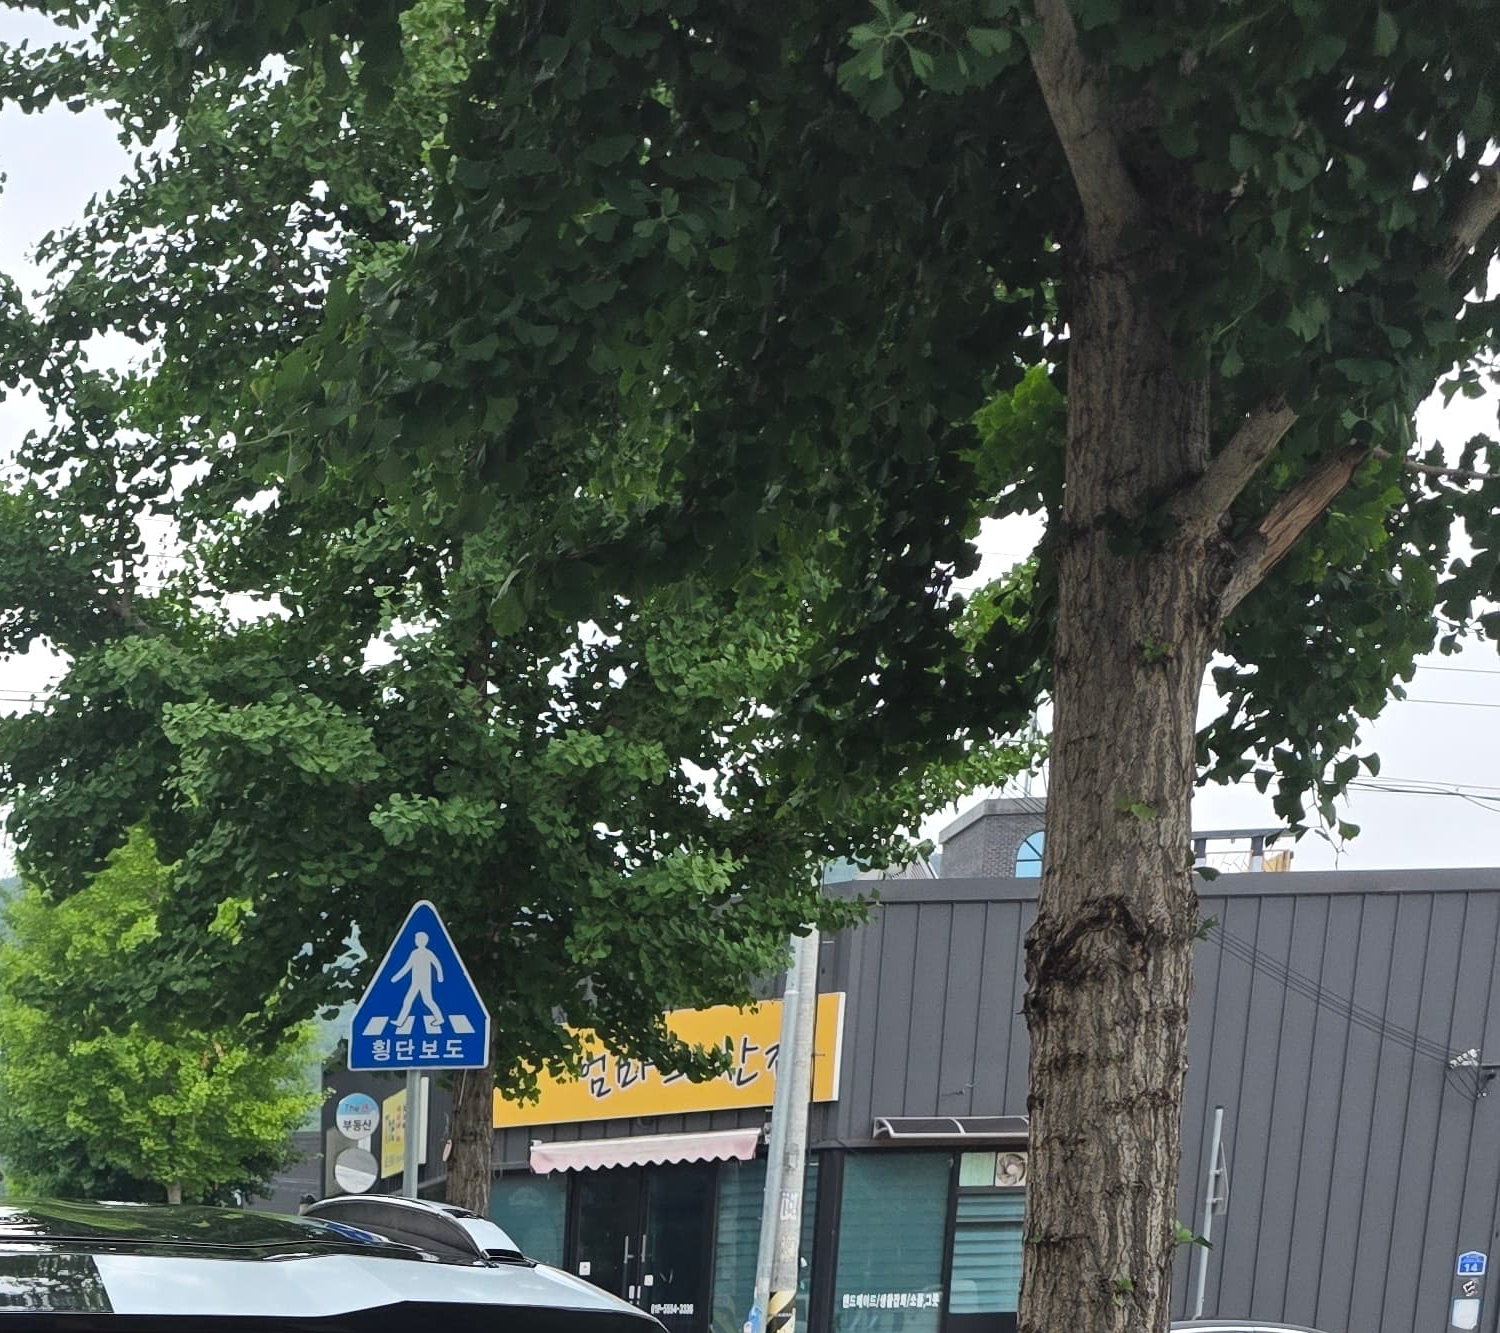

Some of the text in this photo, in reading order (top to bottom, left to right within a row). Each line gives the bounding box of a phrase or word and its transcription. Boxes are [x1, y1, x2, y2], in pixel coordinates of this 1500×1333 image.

[371, 1039, 465, 1062] 횡단보도
[342, 1119, 372, 1131] 부동산
[1463, 1263, 1478, 1272] 14
